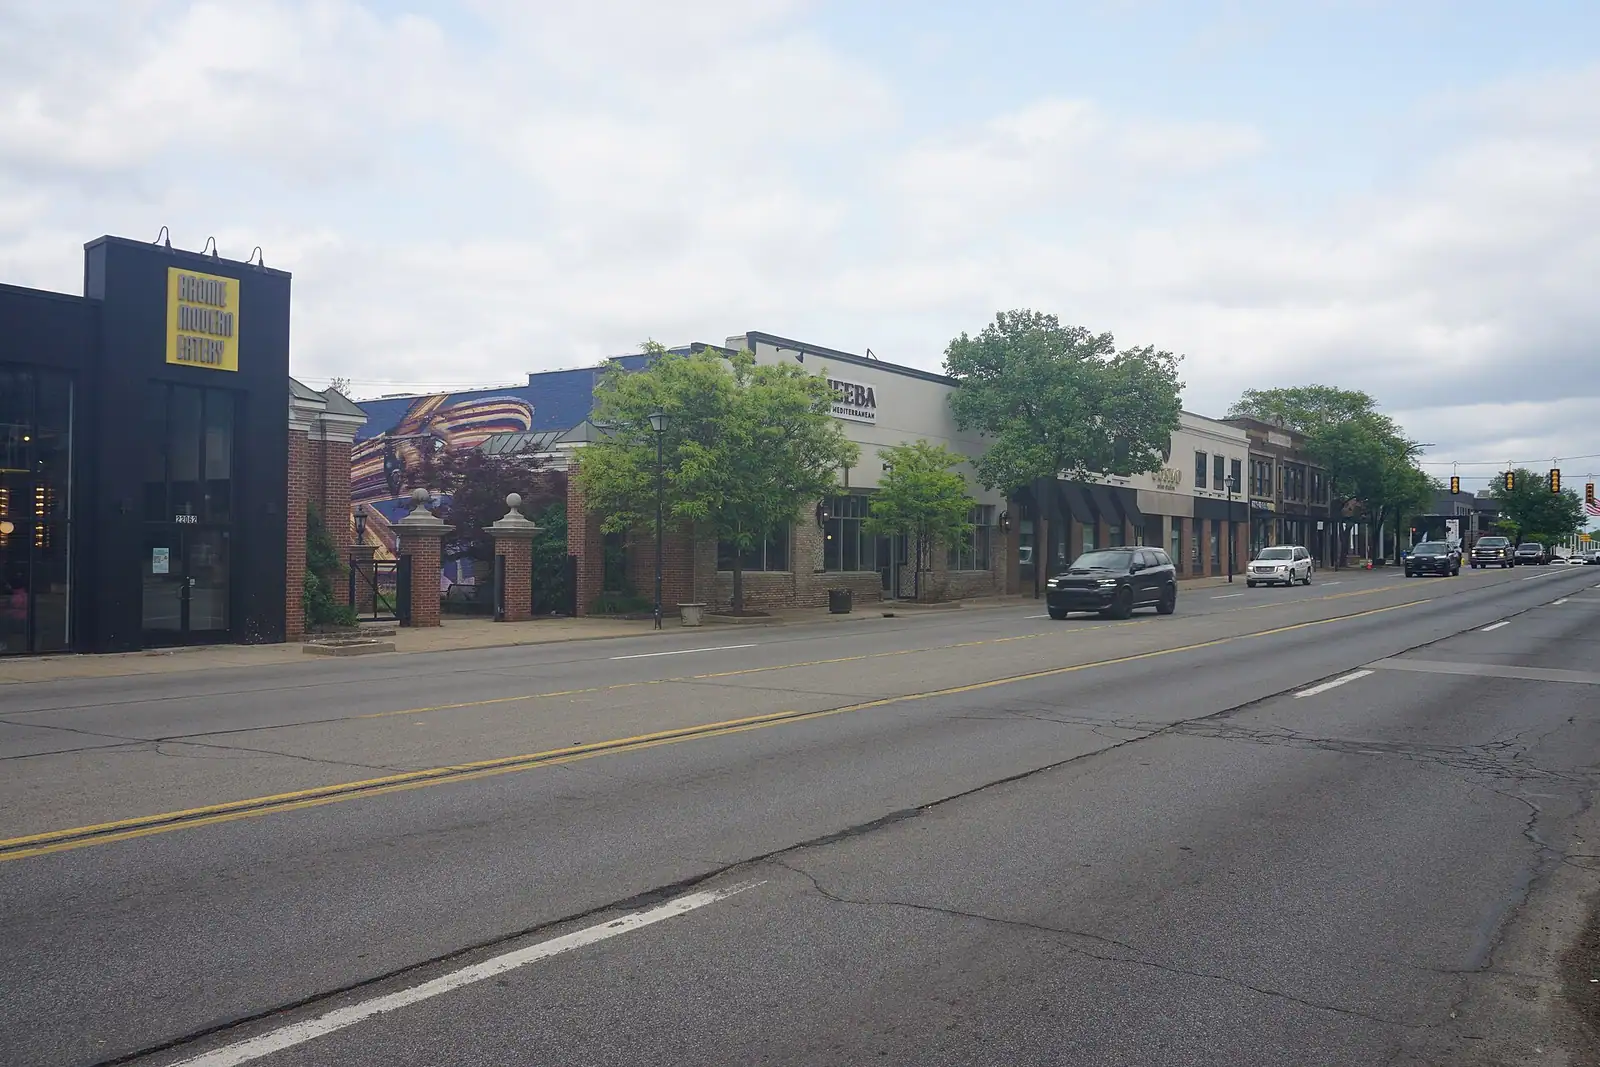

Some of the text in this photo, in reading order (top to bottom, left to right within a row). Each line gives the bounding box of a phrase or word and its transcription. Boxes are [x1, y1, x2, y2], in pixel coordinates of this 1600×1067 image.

[178, 274, 227, 307] BROME
[178, 304, 233, 337] MODERN
[177, 335, 224, 365] EATERY
[827, 378, 877, 408] EEBA
[833, 406, 875, 419] MEDITERRANEAN
